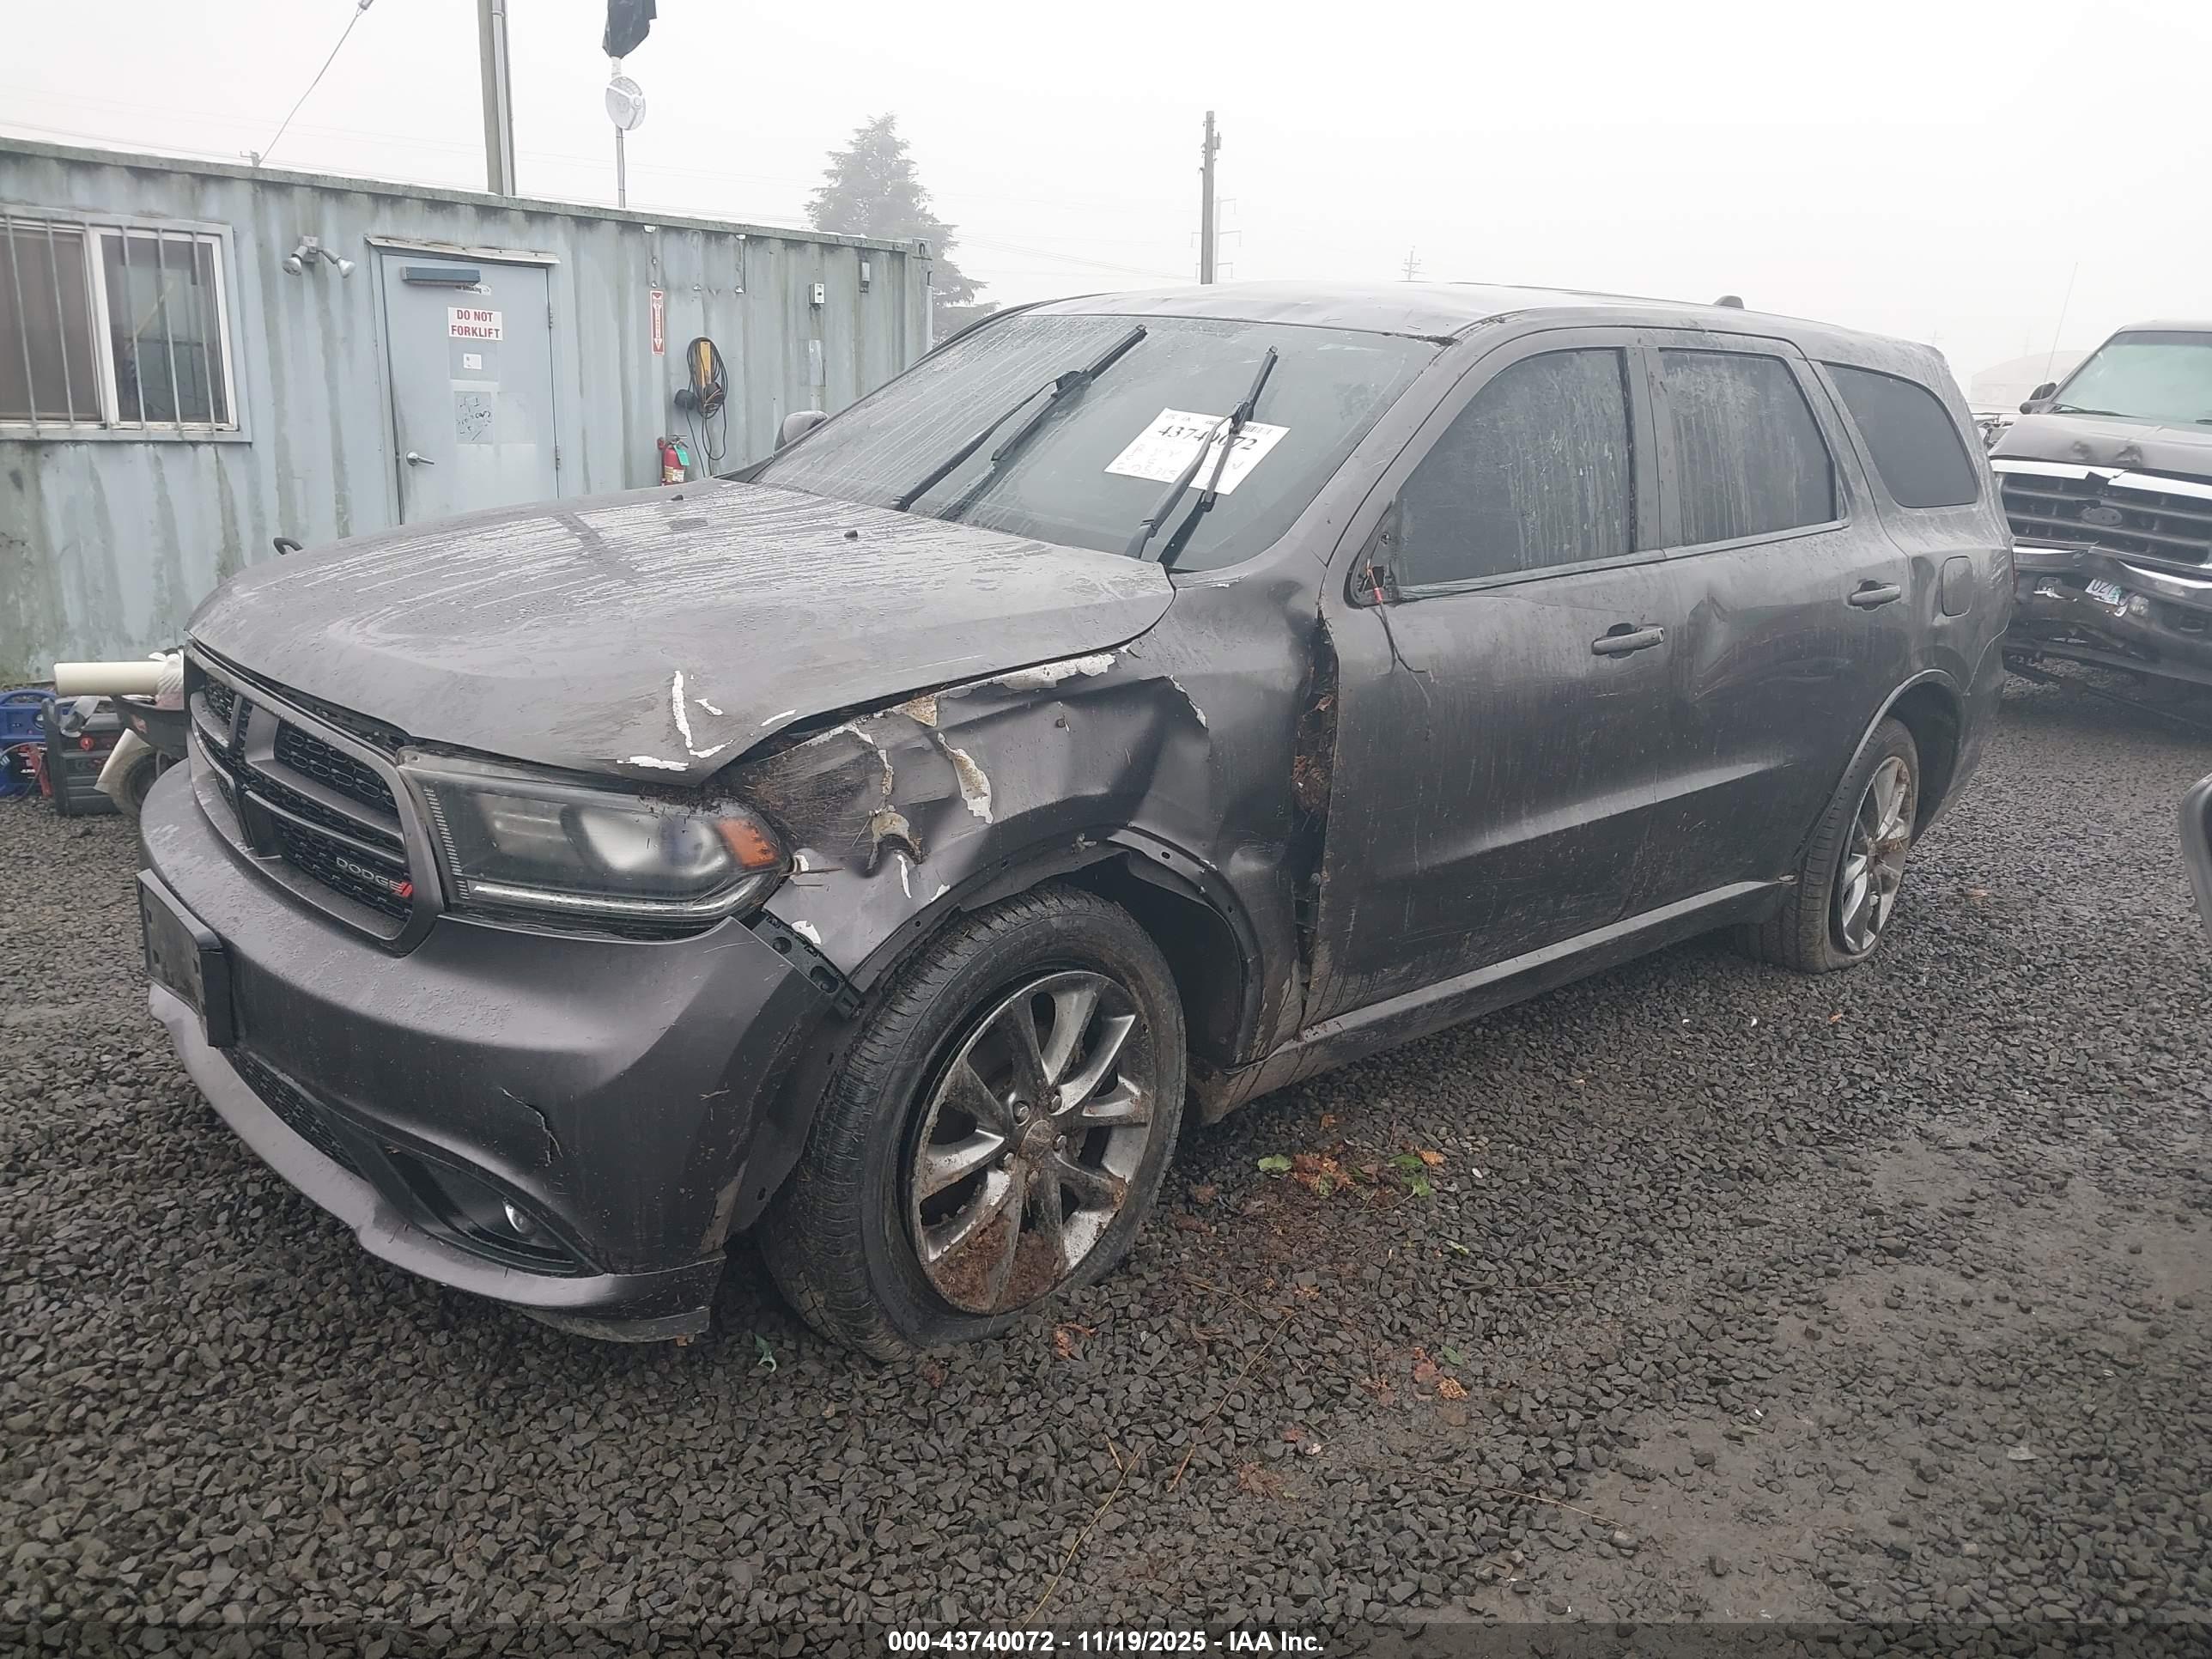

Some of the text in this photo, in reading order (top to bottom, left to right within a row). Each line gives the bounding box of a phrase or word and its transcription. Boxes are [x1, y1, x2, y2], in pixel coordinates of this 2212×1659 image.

[457, 310, 493, 322] DO NOT
[451, 325, 500, 338] FORKLIFT
[336, 857, 405, 893] DODGE
